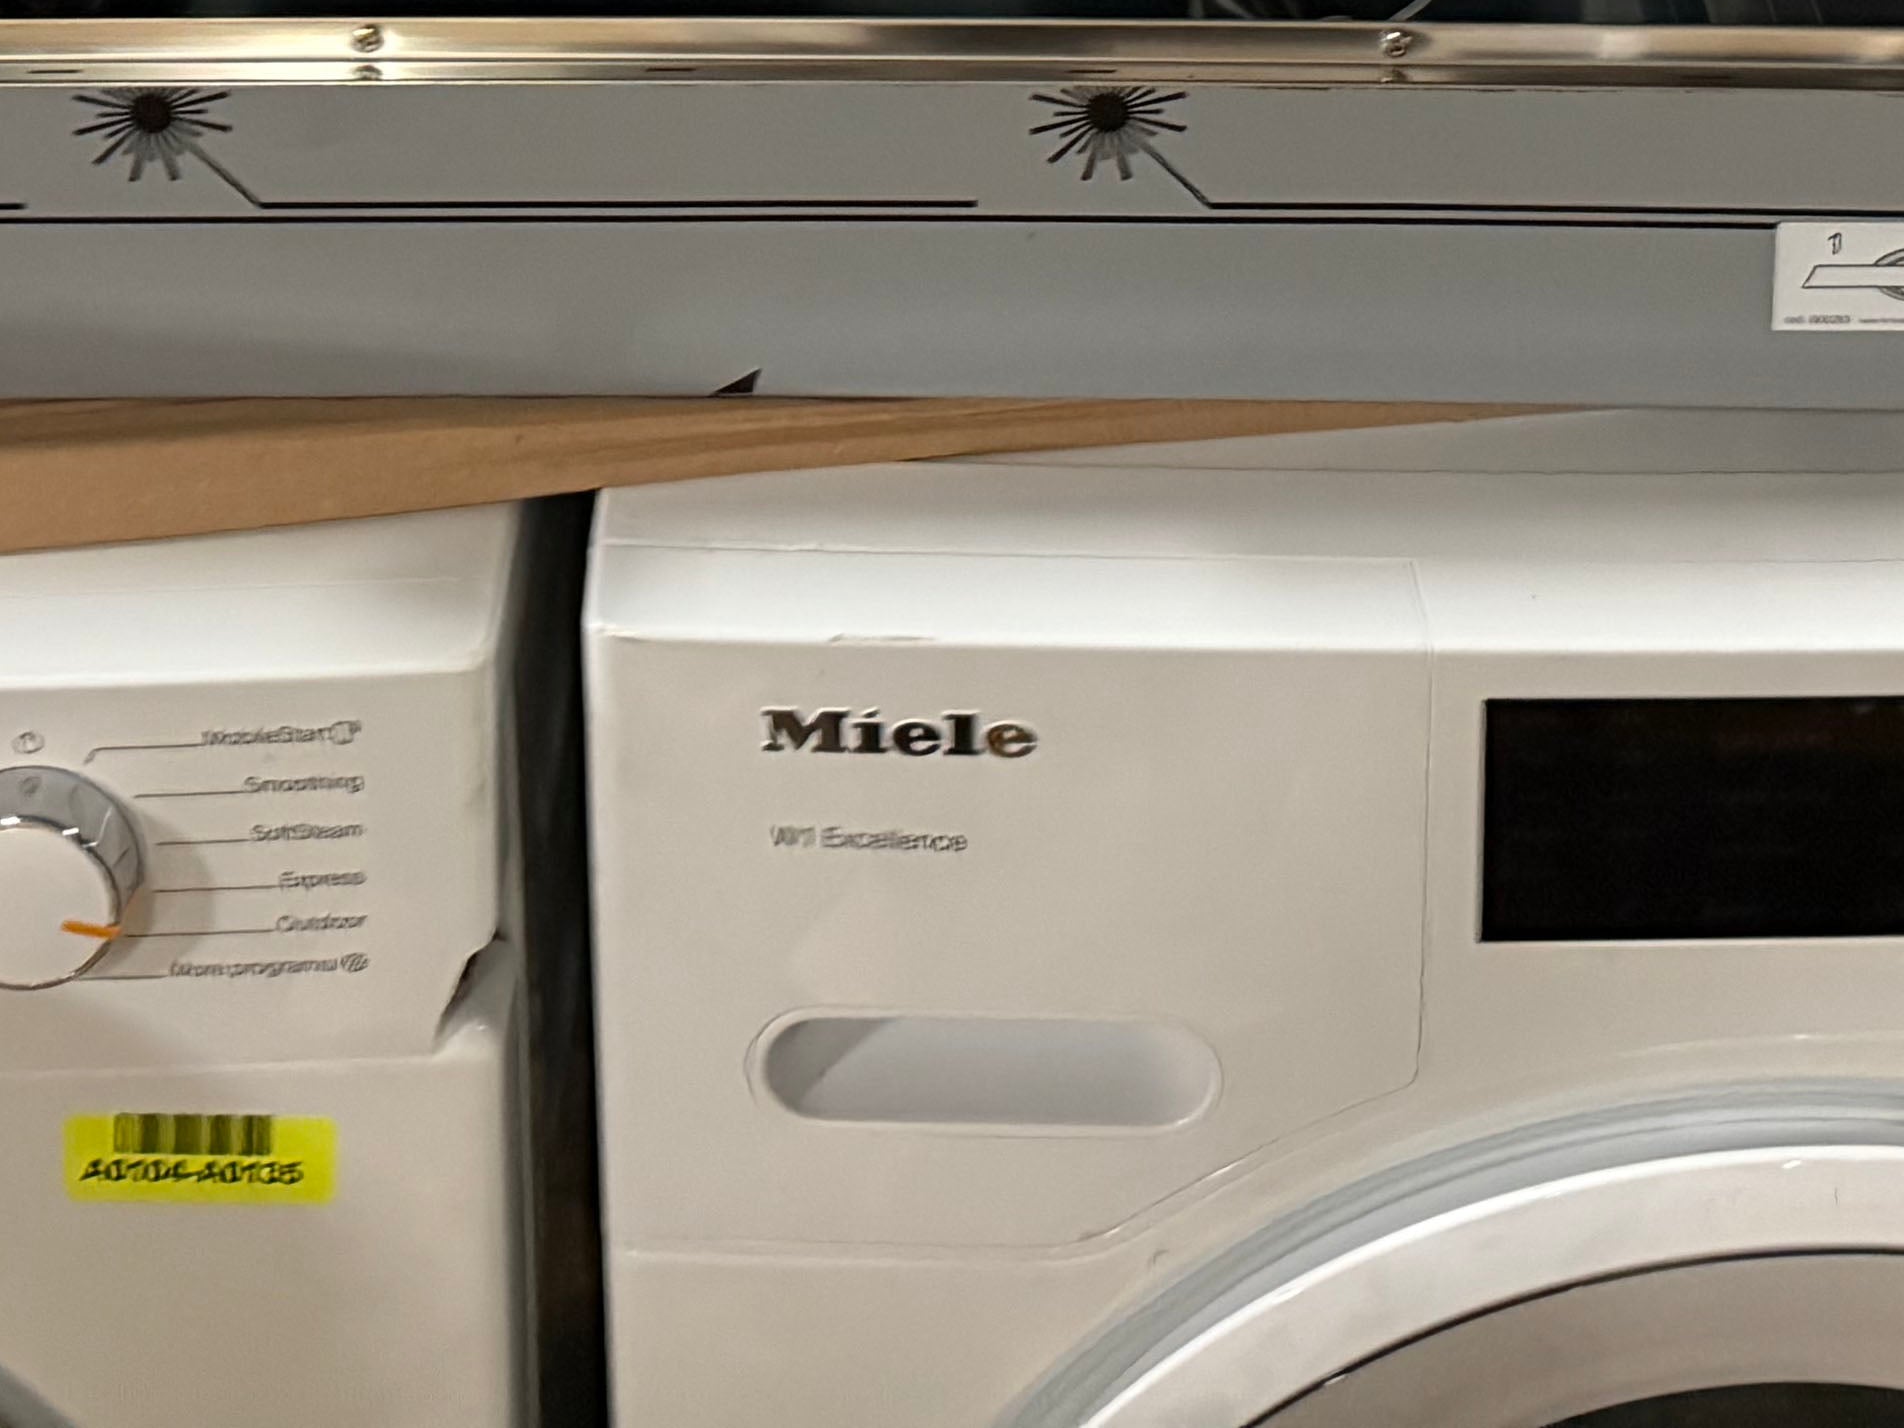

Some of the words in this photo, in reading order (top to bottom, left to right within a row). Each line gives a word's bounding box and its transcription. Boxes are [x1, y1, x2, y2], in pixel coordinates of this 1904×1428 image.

[1827, 232, 1842, 255] 1
[760, 707, 1039, 759] Miele
[821, 826, 969, 852] Excellence
